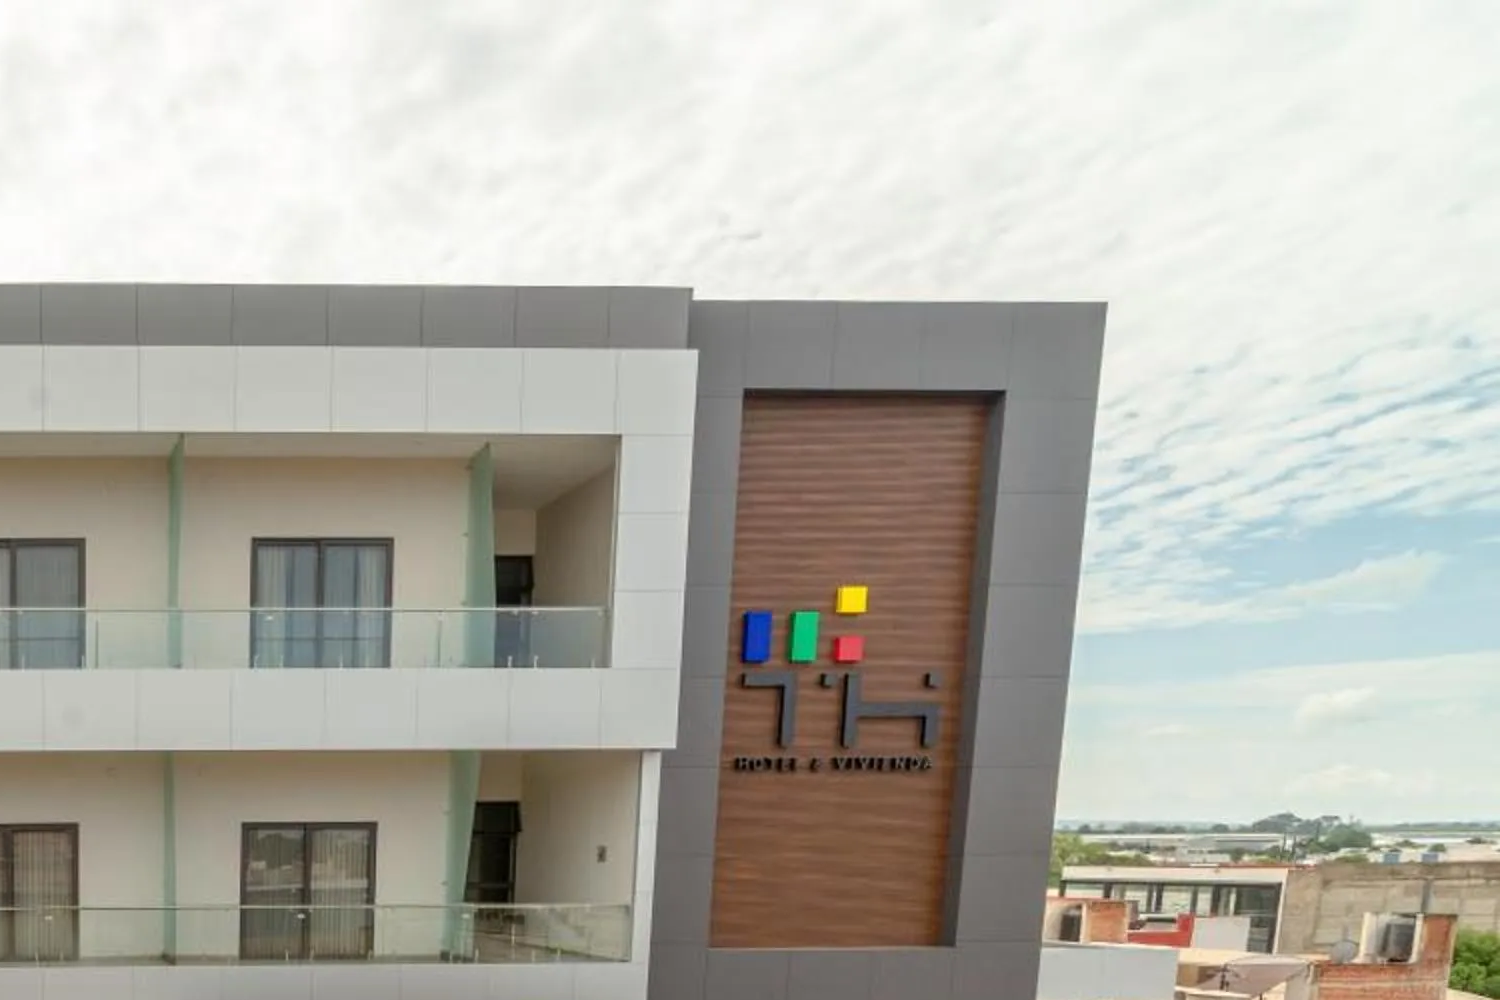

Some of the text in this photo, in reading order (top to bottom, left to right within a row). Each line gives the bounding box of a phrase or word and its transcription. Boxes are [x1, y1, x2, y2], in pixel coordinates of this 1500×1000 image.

[734, 756, 933, 773] HOTEL & VIVIENDA
